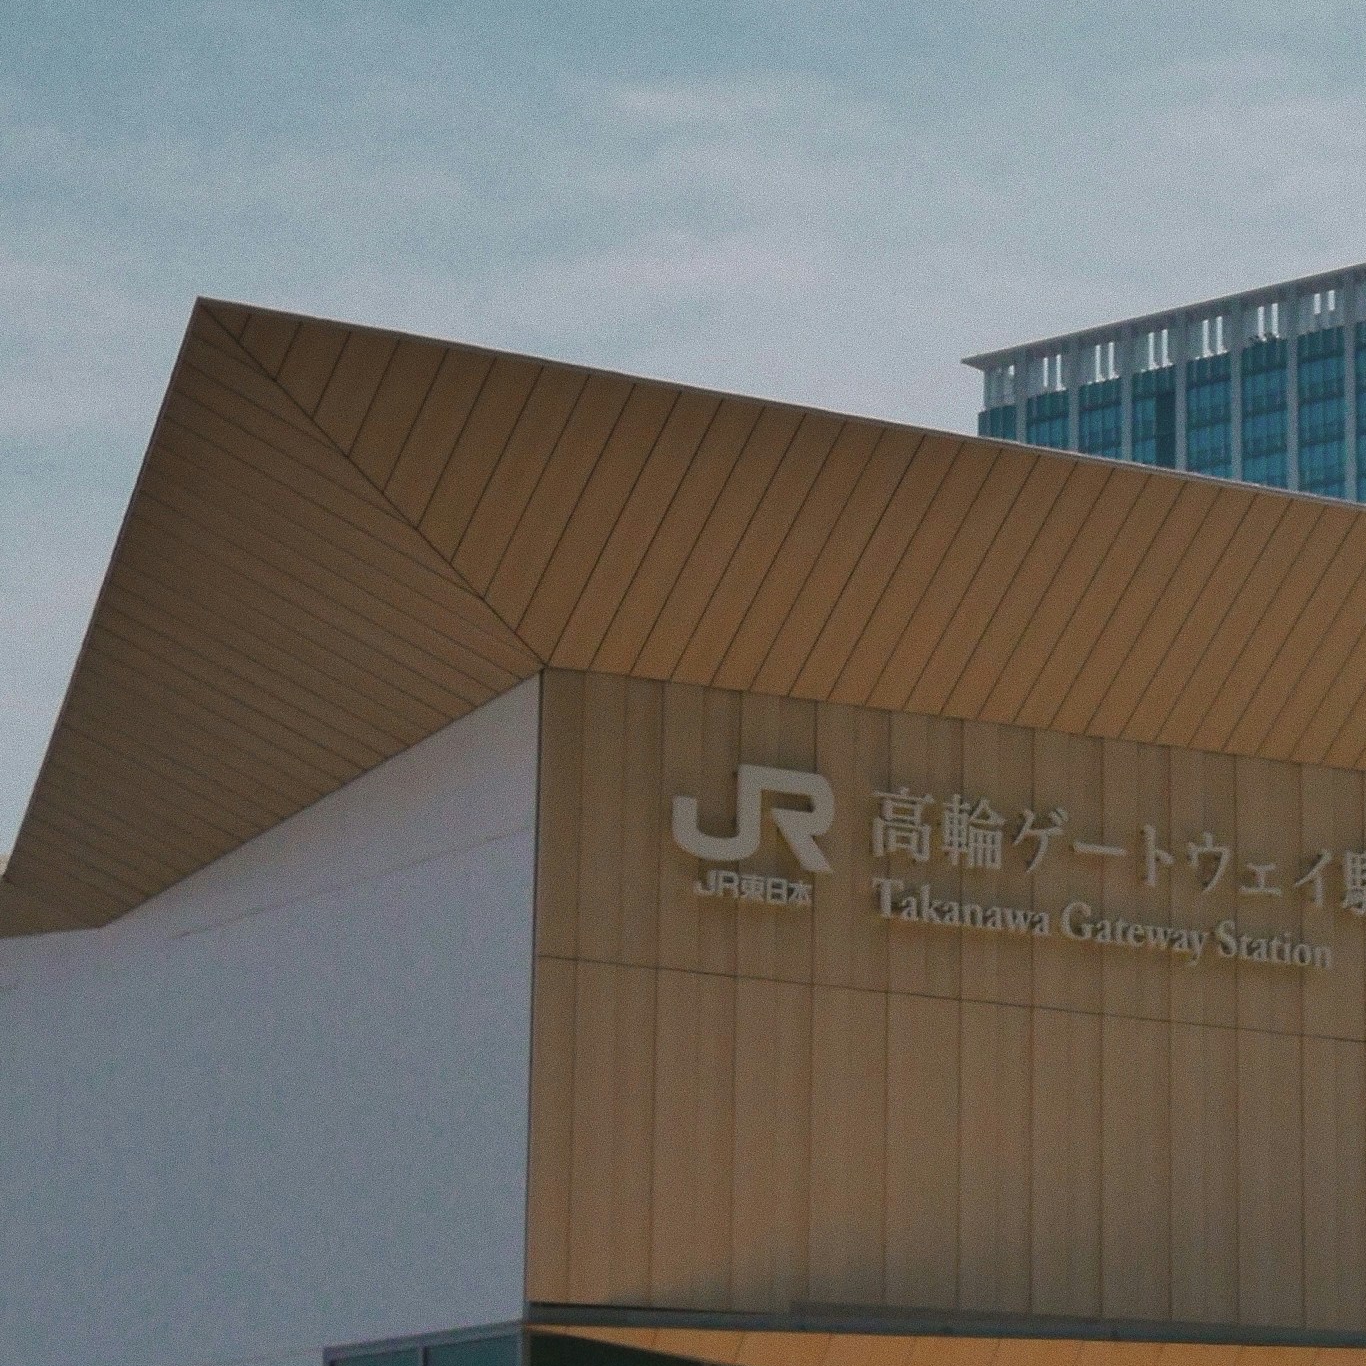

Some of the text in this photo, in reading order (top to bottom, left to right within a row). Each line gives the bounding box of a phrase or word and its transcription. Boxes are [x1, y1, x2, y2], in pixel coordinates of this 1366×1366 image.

[671, 763, 835, 873] JR
[693, 869, 813, 906] JR東日本
[871, 876, 1332, 968] Takanawa Gateway Station
